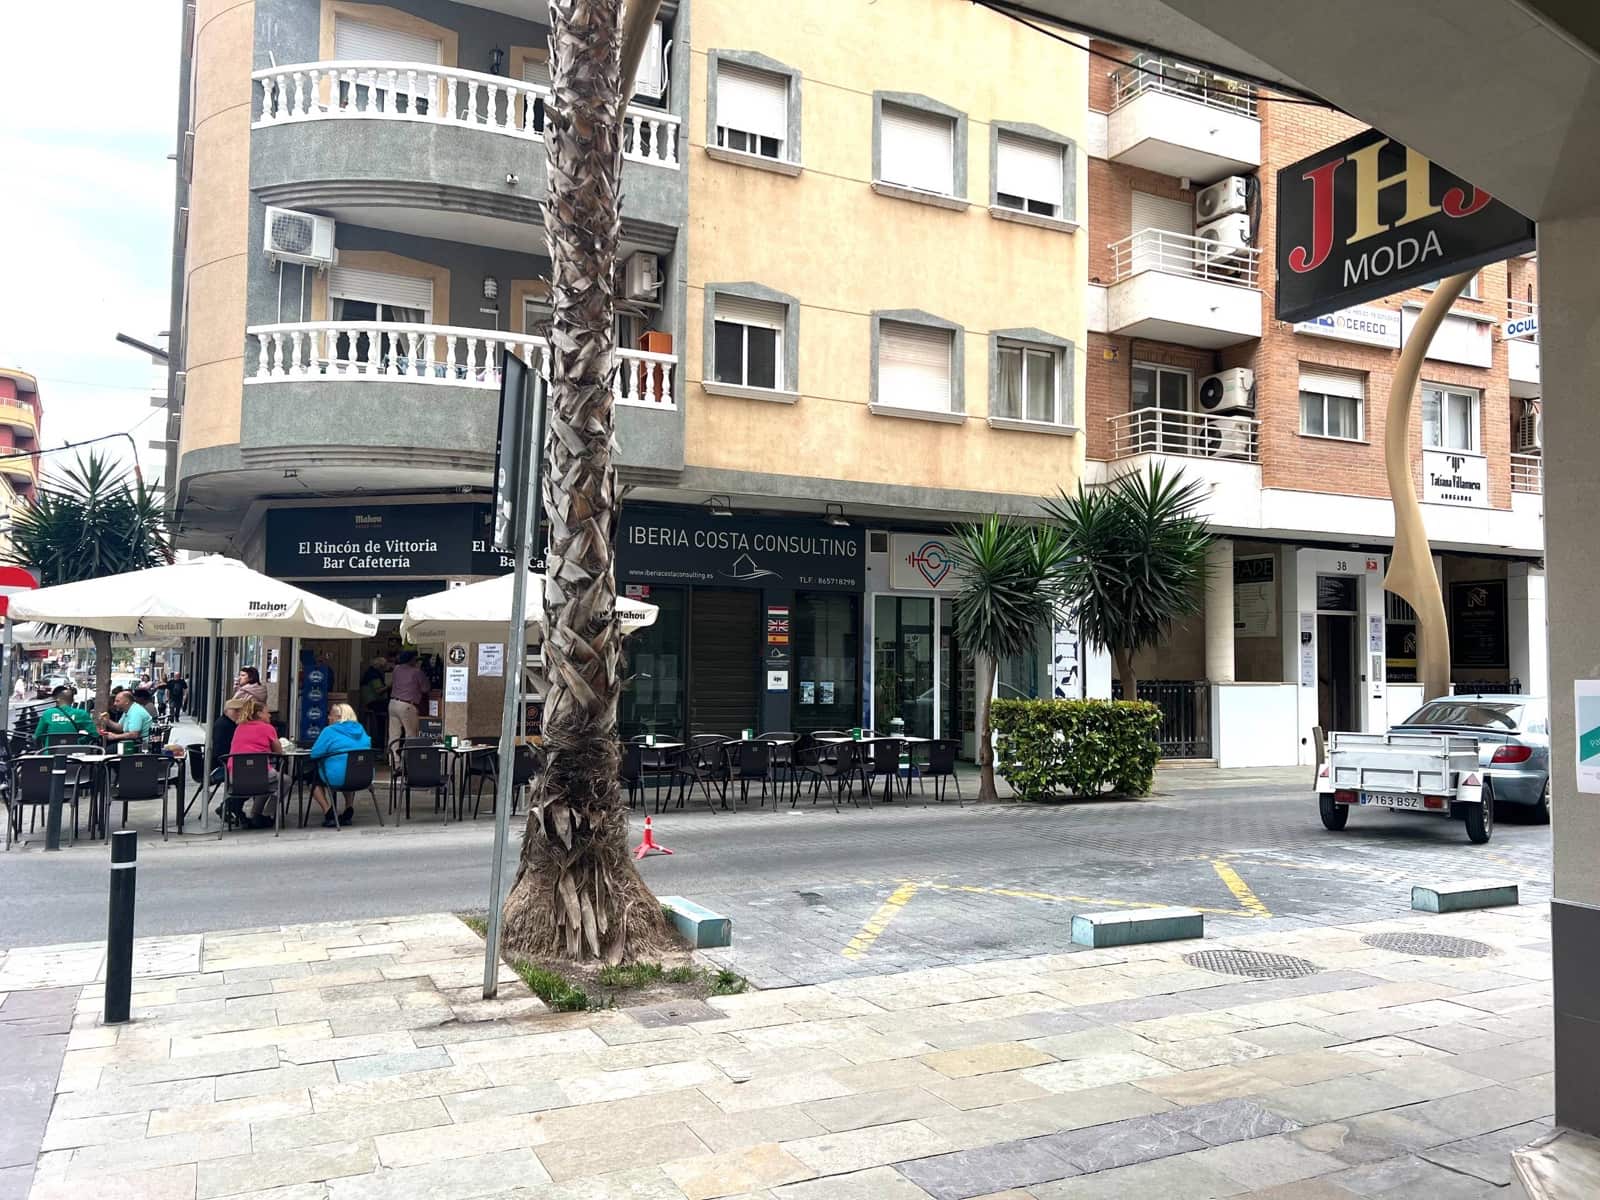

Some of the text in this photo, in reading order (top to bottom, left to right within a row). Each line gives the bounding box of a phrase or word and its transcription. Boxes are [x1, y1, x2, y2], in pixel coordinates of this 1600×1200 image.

[1343, 230, 1443, 287] MODA
[1346, 318, 1386, 335] CERECO
[1507, 319, 1537, 335] OCUL
[1430, 472, 1452, 488] Tatiana
[298, 538, 438, 555] El Rincón de Vittoria
[472, 540, 486, 553] El
[629, 526, 857, 557] IBERIA COSTA CONSULTING
[323, 555, 410, 570] Bar Cafetería
[500, 555, 515, 567] Ba
[1336, 560, 1348, 572] 38
[629, 569, 714, 579] www.iberiacostaconsulting.es
[1367, 794, 1418, 808] 7163 BSZ
